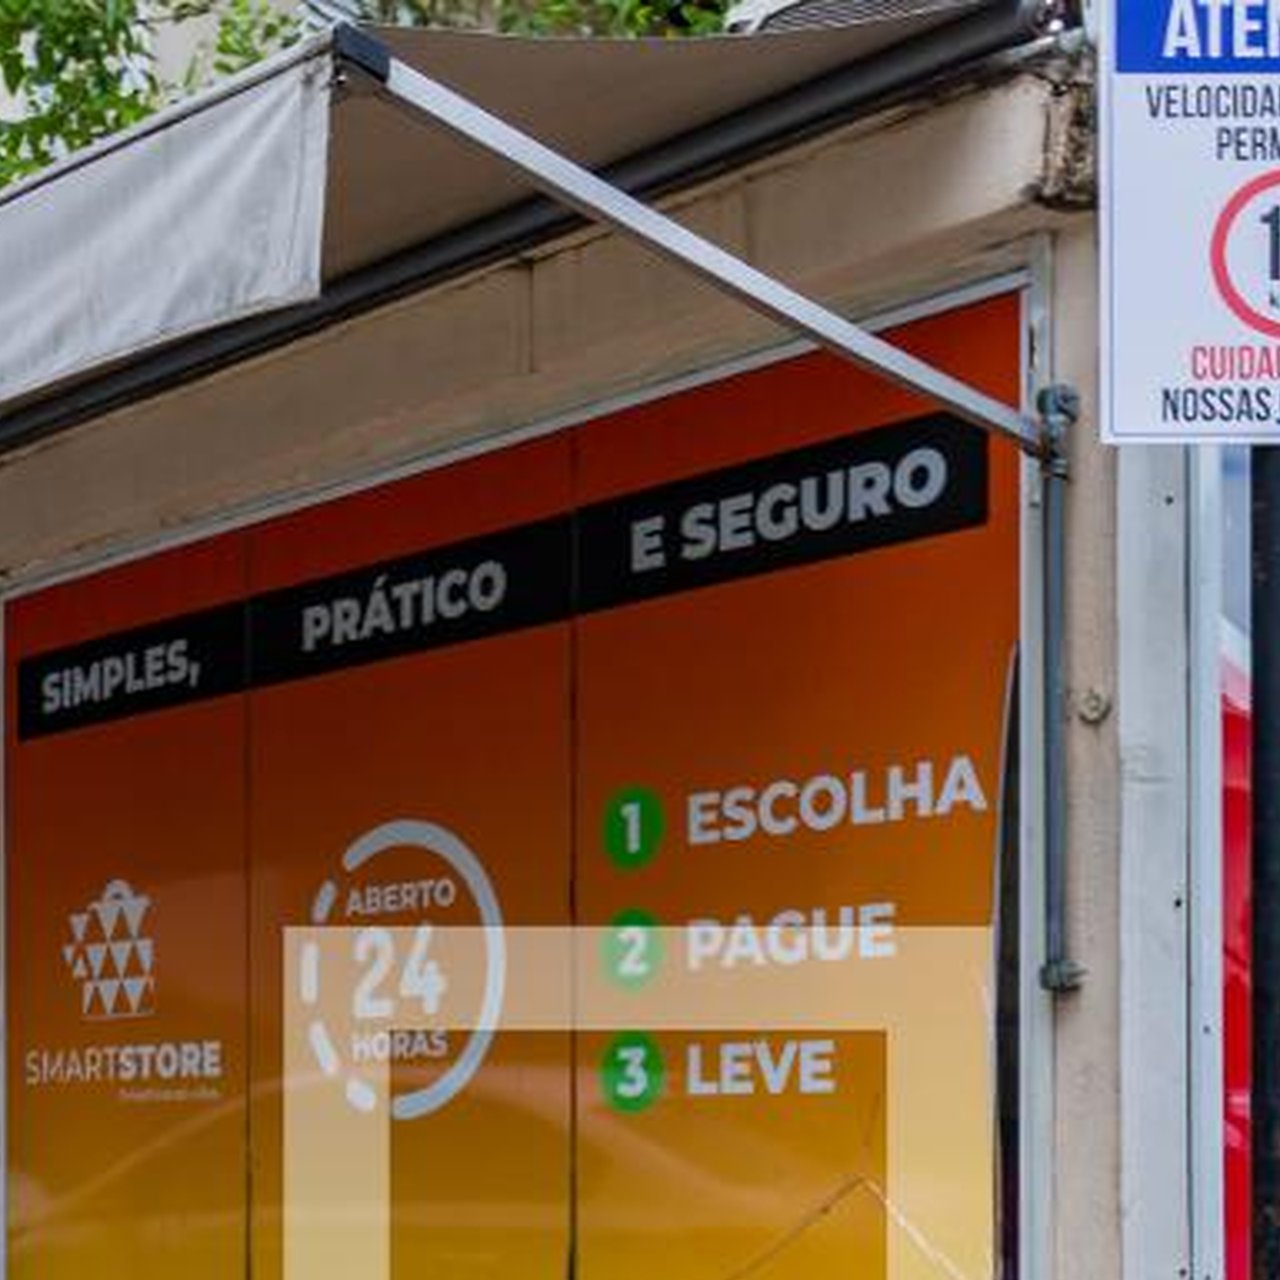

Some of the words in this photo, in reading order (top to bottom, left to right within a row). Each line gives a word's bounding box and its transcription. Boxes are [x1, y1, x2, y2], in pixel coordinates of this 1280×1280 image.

[1162, 388, 1271, 423] NOSSAS
[41, 640, 200, 714] SIMPLES,
[301, 560, 506, 651] PRÁTICO
[630, 516, 665, 573] E
[680, 447, 947, 562] SEGURO
[621, 803, 641, 853] 1
[688, 756, 988, 845] ESCOLHA
[345, 878, 457, 917] ABERTO
[618, 927, 649, 975] 2
[688, 904, 897, 971] PAGUE
[352, 921, 447, 1019] 24
[26, 1040, 222, 1086] SMARTSTORE
[352, 1030, 449, 1062] HORAS
[617, 1047, 649, 1097] 3
[688, 1041, 837, 1094] LEVE
